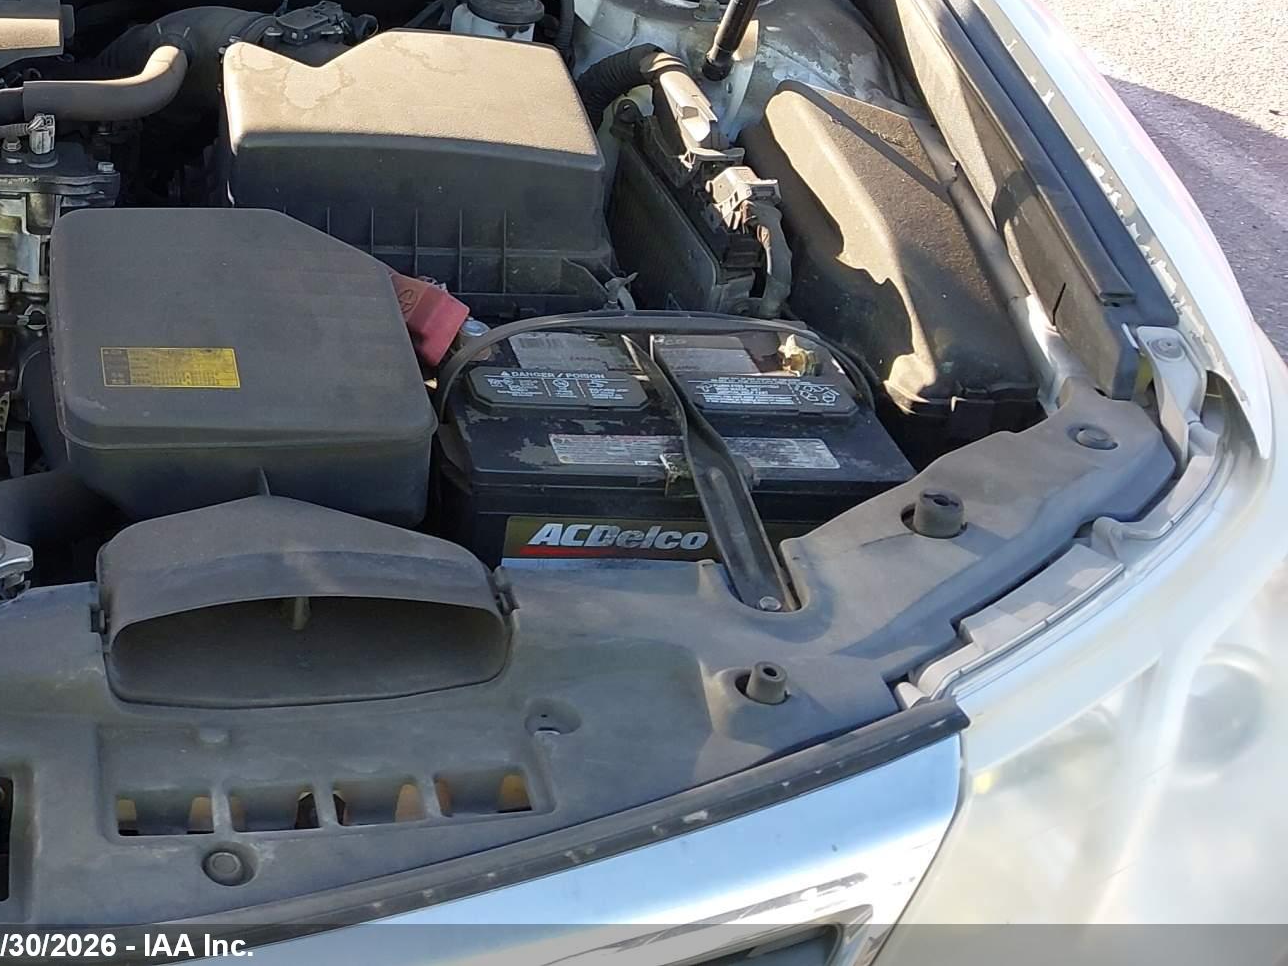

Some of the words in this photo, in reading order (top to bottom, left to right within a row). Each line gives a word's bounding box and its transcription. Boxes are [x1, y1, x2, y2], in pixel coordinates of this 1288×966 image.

[511, 371, 556, 379] DANGER
[565, 371, 606, 380] POISON
[526, 522, 711, 550] ACDelco
